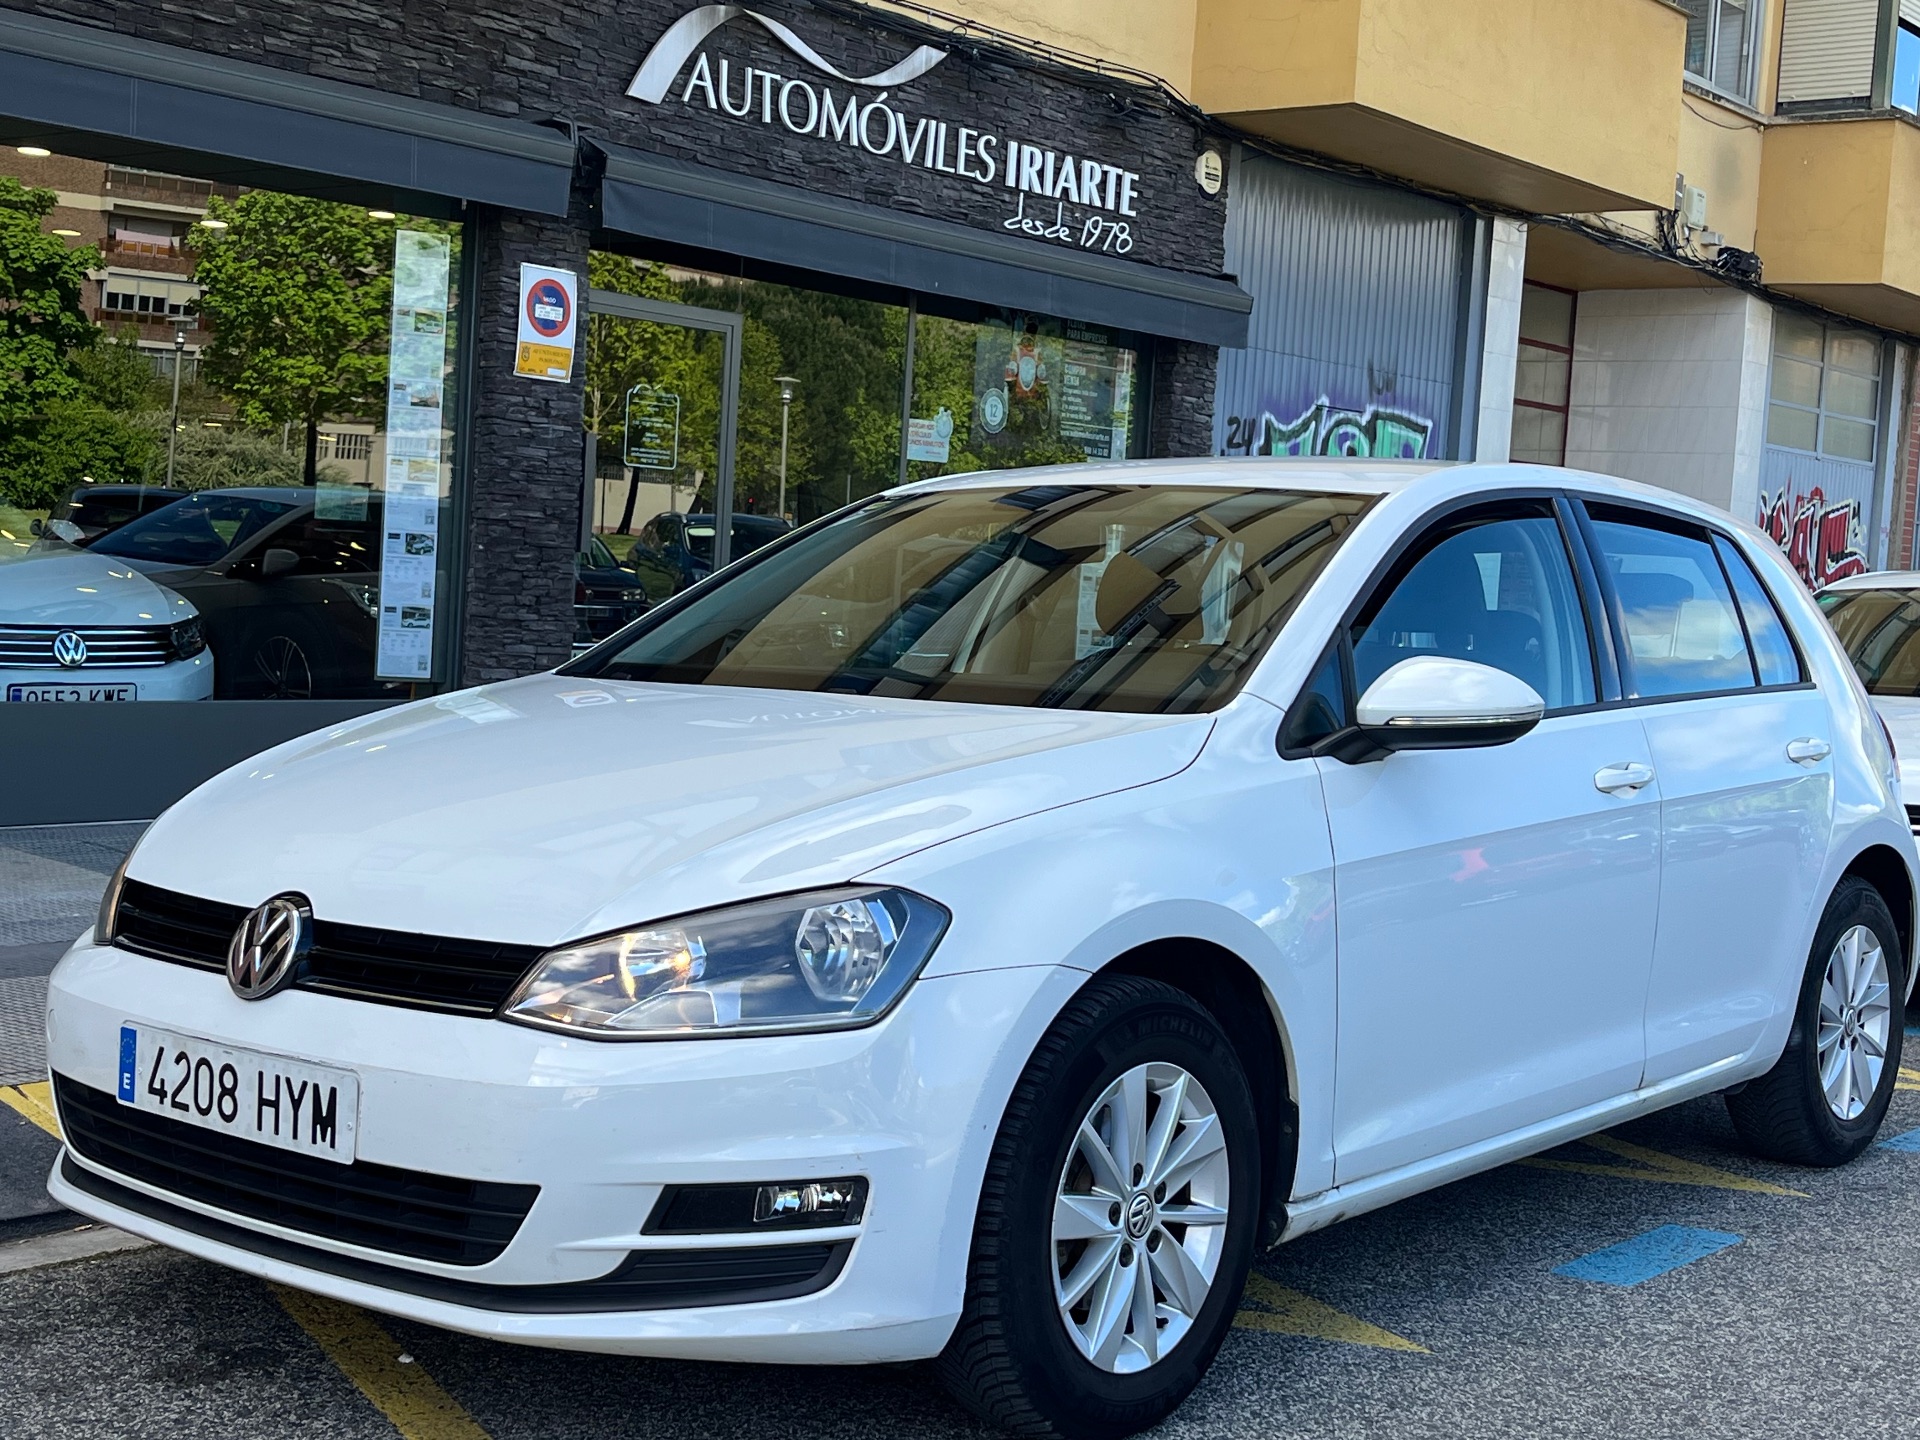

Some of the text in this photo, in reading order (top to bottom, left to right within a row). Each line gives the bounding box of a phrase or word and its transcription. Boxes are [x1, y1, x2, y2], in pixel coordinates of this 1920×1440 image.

[681, 52, 1140, 218] AUTOMÓVILES IRIARTE
[1004, 192, 1133, 254] desde 1978
[990, 404, 998, 418] 12
[1138, 1015, 1214, 1047] MICHELIN
[123, 1072, 131, 1090] E
[147, 1046, 338, 1149] 4208 HYM
